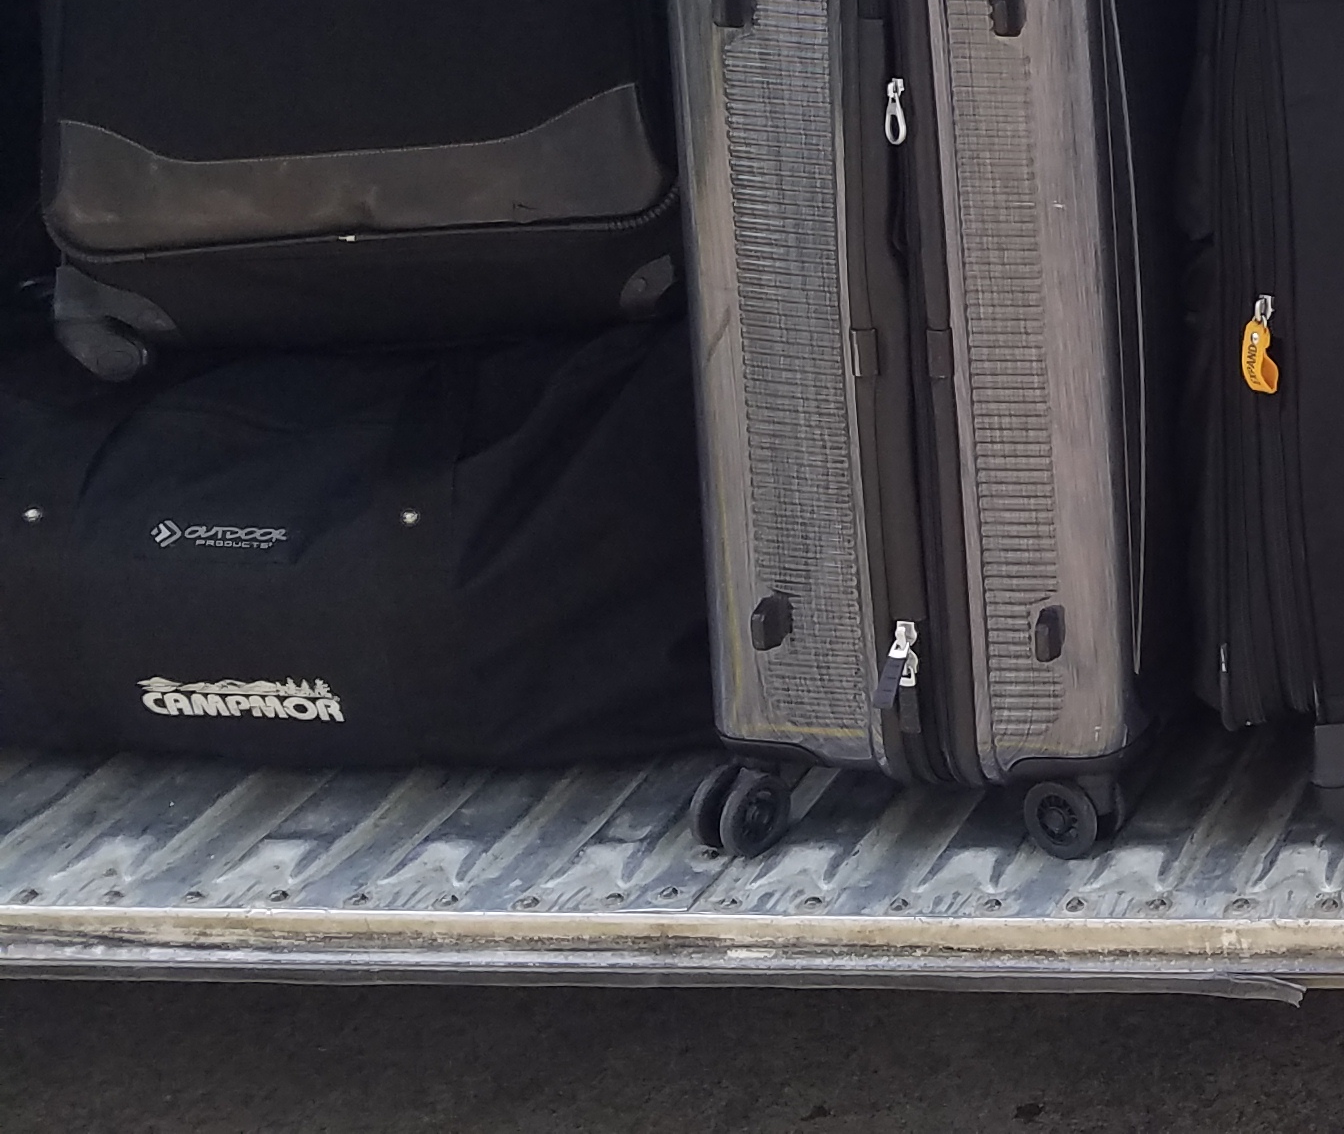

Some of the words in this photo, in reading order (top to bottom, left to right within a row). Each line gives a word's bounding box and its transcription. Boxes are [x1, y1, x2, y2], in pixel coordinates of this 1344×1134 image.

[1246, 343, 1261, 385] EXPAND
[184, 525, 287, 542] OUTDOOR
[195, 539, 270, 549] PRODUCTS
[142, 692, 345, 723] CAMPMOR
